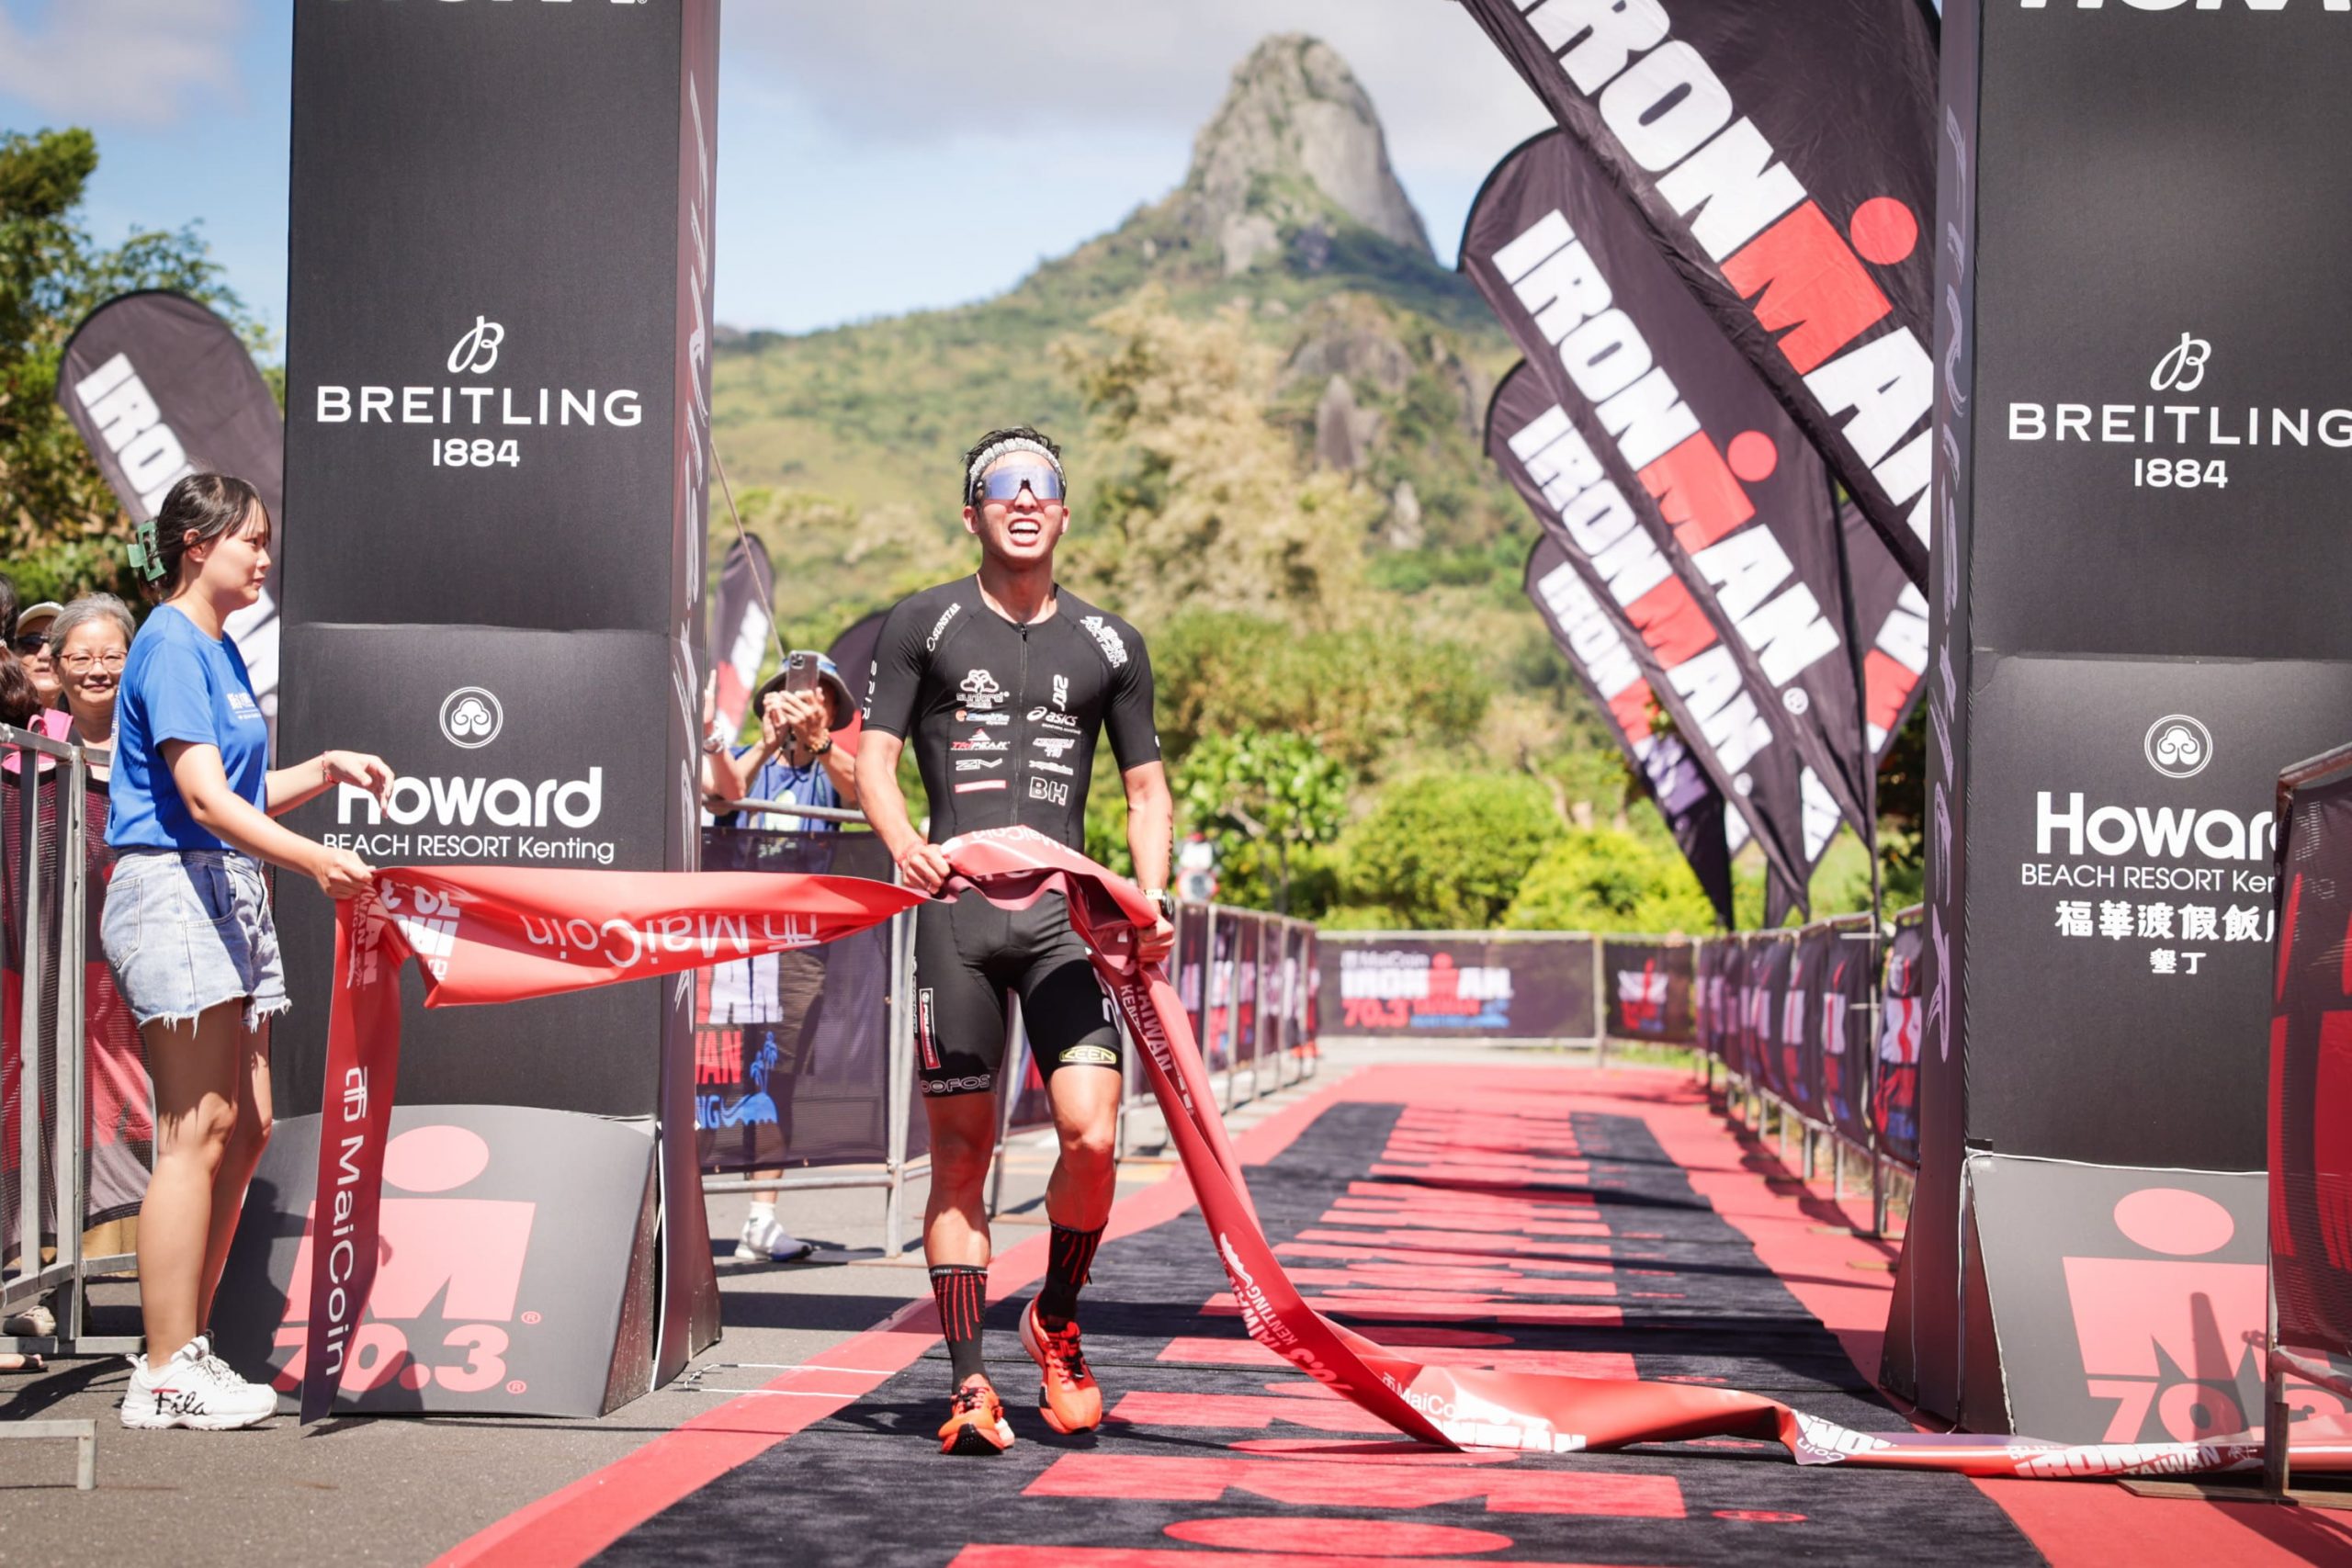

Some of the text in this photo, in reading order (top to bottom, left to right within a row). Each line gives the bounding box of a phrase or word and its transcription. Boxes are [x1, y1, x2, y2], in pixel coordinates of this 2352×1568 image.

[1511, 0, 1933, 551] RONMA
[317, 386, 642, 427] BREITLING
[2008, 402, 2352, 447] BREITLING
[433, 437, 521, 468] 1884
[1491, 209, 1840, 688] IRONMAN
[2134, 457, 2228, 489] 1884
[1045, 711, 1078, 727] asics
[1028, 776, 1069, 807] BH
[2036, 791, 2278, 861] Howar
[323, 833, 615, 865] BEACH RESORT Kenting
[2021, 863, 2115, 888] BEACH
[2123, 866, 2225, 891] RESORT
[519, 913, 751, 968] MaiCoin
[2054, 899, 2274, 942] 福華渡假飯
[2149, 947, 2207, 975] 墾丁
[325, 1134, 365, 1376] MaiCoin
[1246, 1284, 1298, 1346] KENTING
[151, 1388, 209, 1416] Fila
